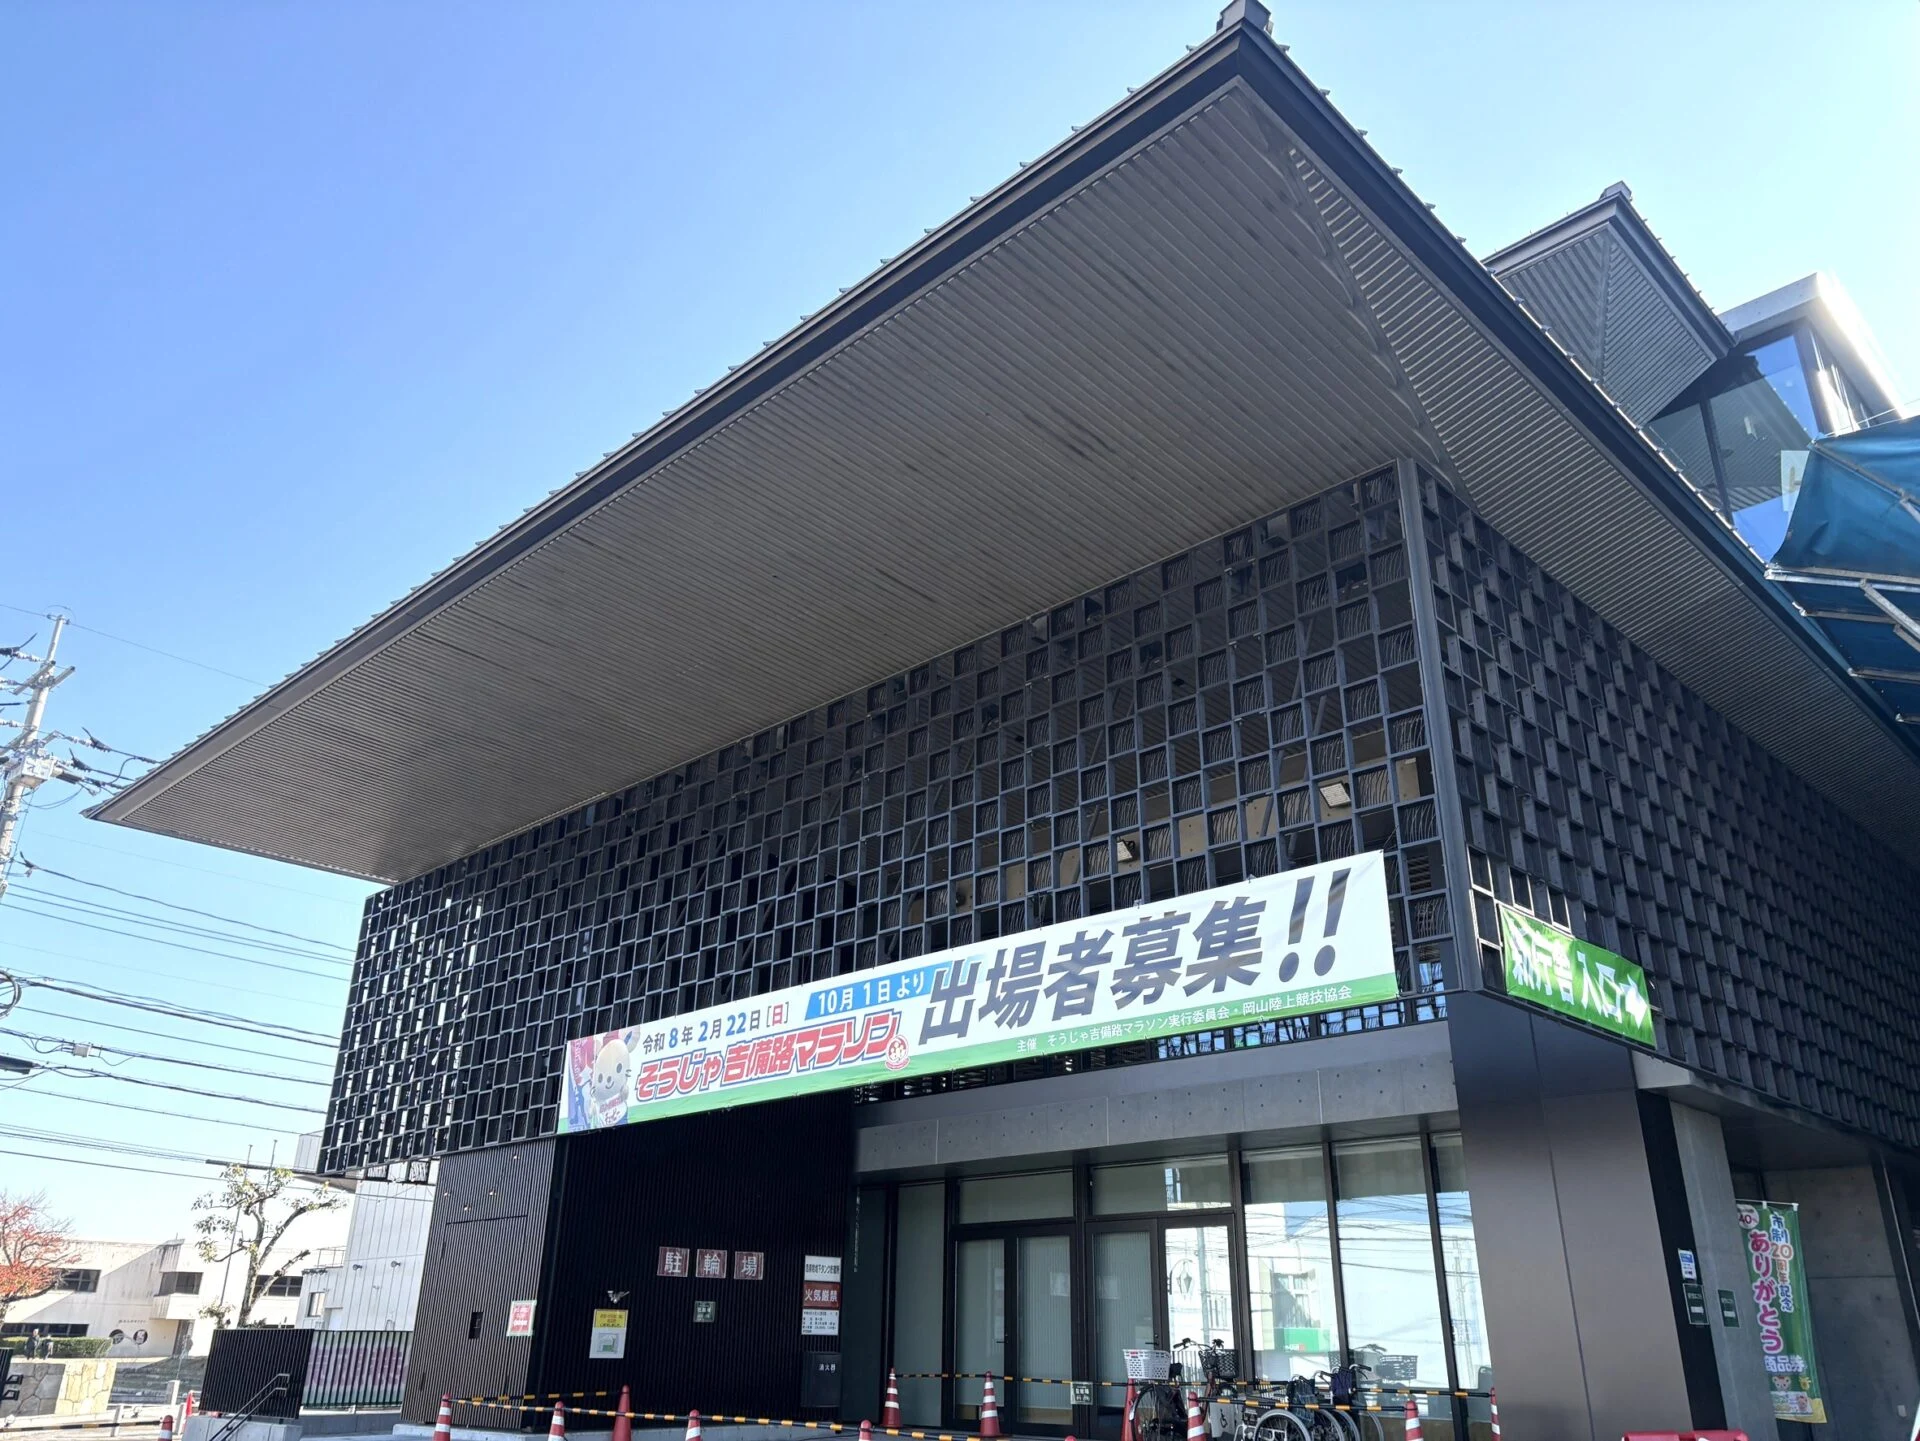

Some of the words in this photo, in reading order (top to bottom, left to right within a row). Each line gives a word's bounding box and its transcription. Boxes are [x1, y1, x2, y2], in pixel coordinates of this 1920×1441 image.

[818, 973, 924, 1016] 10月1日より
[637, 1010, 900, 1100] そうじゃ吉備路マラソン
[1016, 1039, 1038, 1053] 主催
[804, 1288, 838, 1302] 火気厳禁
[1749, 1230, 1783, 1353] ありがとう
[1771, 1212, 1793, 1312] 市制20周年記念
